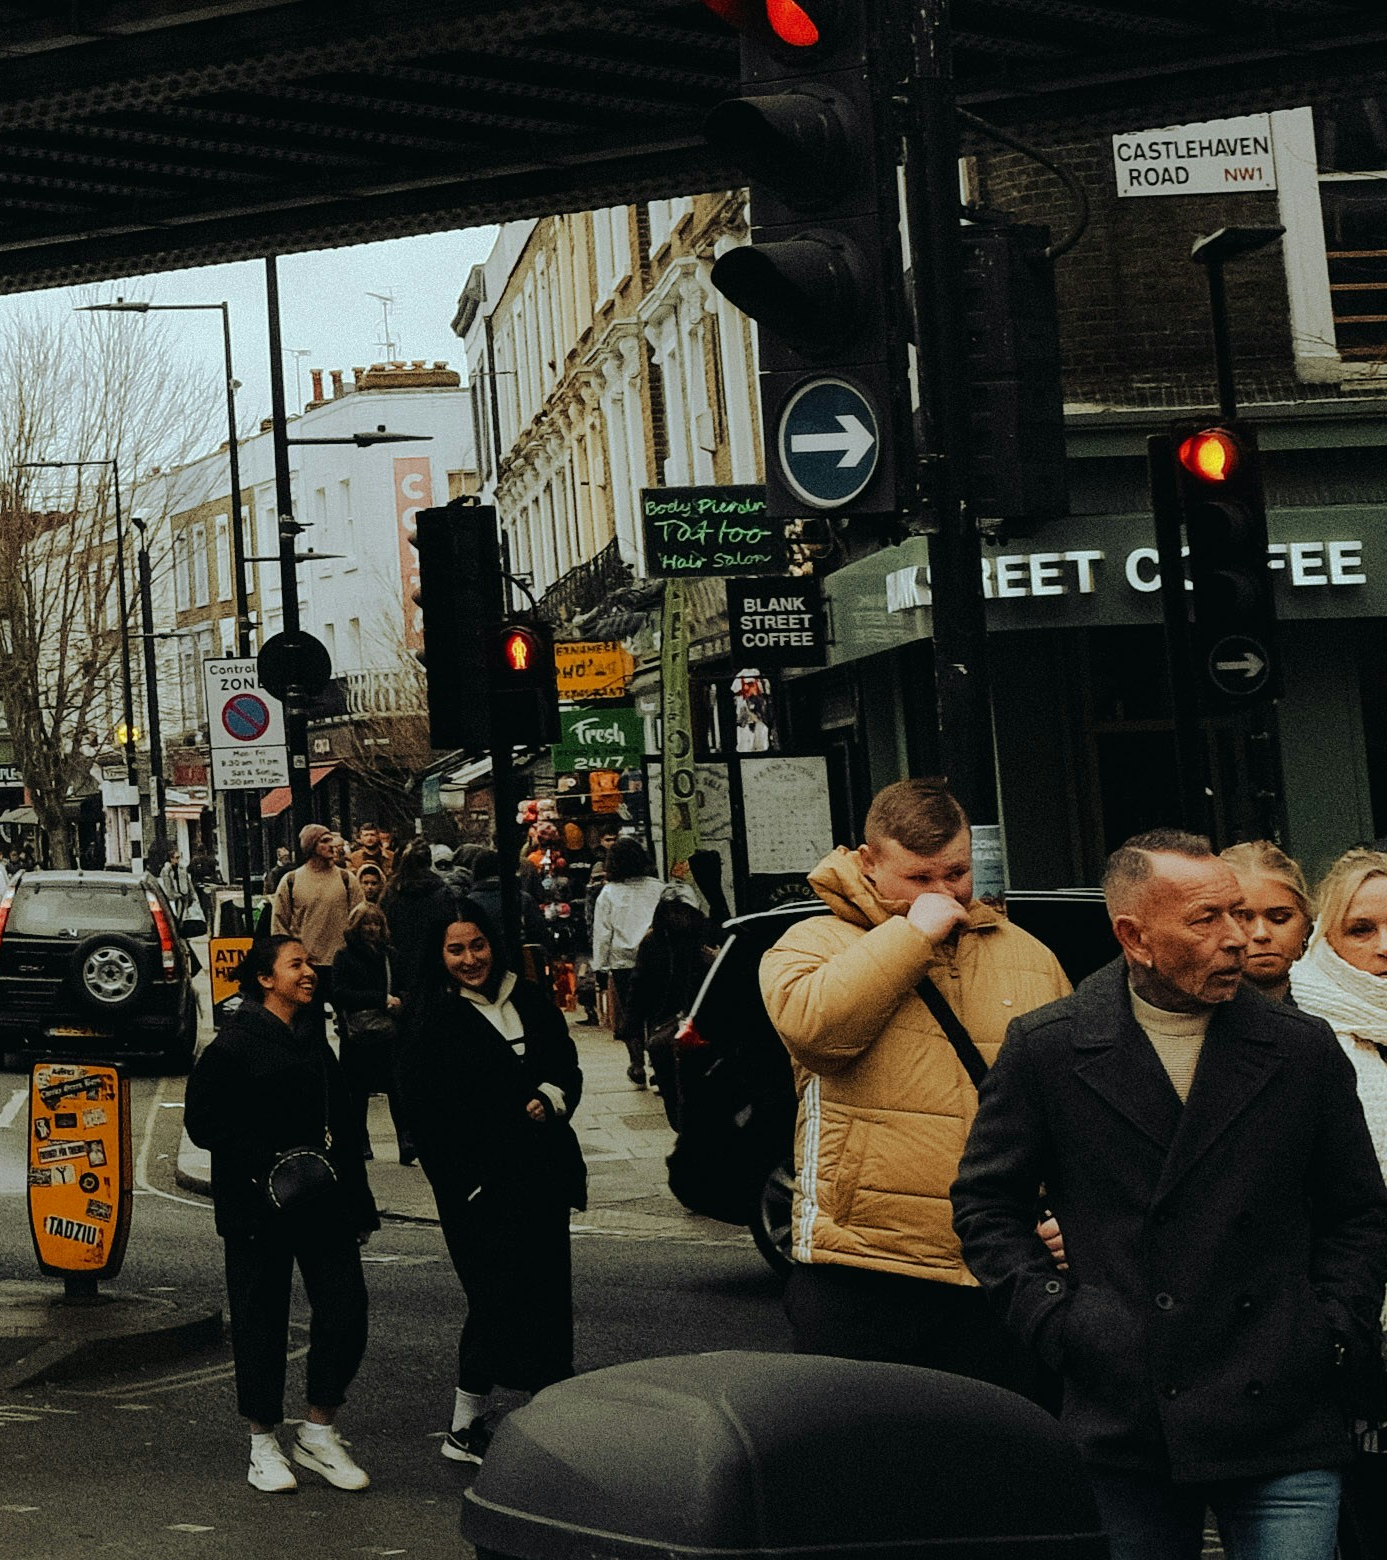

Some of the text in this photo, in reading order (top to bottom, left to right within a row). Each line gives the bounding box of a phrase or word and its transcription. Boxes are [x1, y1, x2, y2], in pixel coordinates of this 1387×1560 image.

[1116, 135, 1270, 162] CASTLEHAVEN
[1128, 166, 1264, 187] ROAD NW1
[653, 519, 773, 546] Tattoo
[712, 551, 772, 568] Salon
[742, 596, 806, 614] BLANK
[740, 614, 814, 631] STREET
[741, 631, 815, 648] COFFEE
[209, 663, 257, 675] Control
[568, 717, 627, 747] Fresh
[574, 755, 625, 770] 24/7
[49, 1215, 97, 1246] TADZIU
